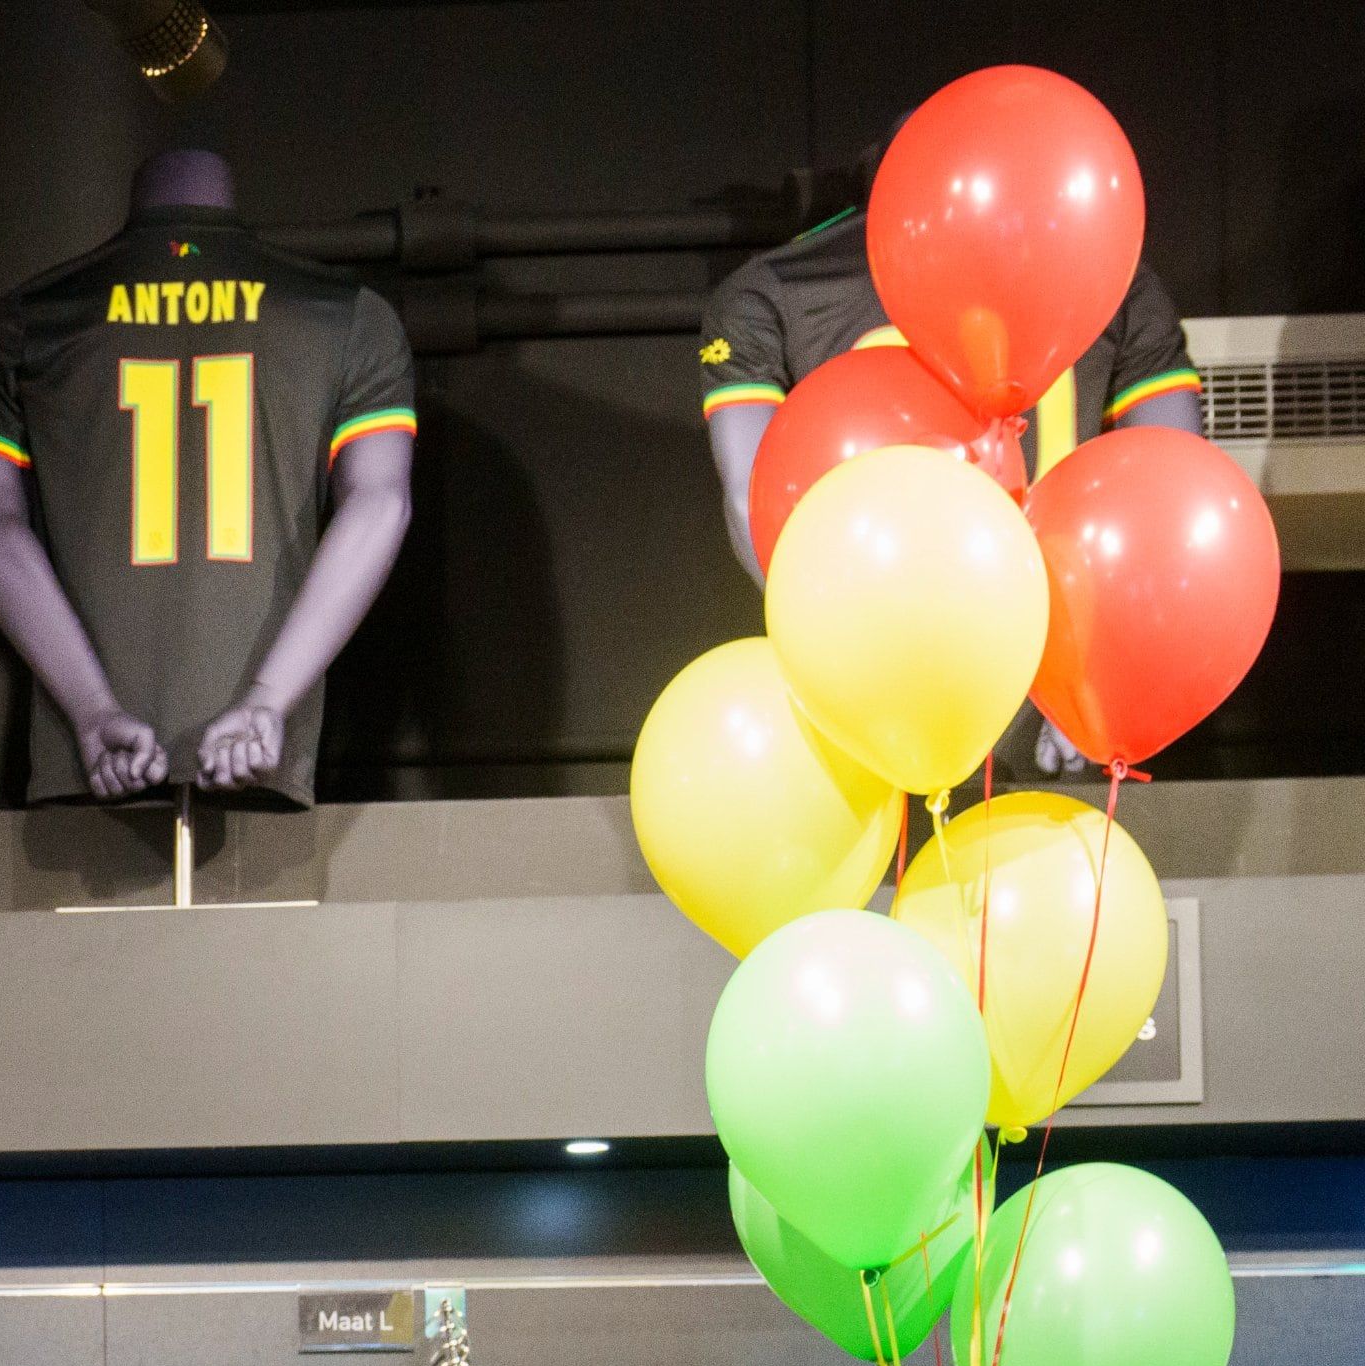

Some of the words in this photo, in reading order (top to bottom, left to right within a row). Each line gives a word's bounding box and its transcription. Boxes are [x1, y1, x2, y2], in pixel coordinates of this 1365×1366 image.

[106, 280, 266, 326] ANTONY
[118, 352, 255, 567] 11
[318, 1310, 373, 1331] Maat
[379, 1310, 394, 1331] L
